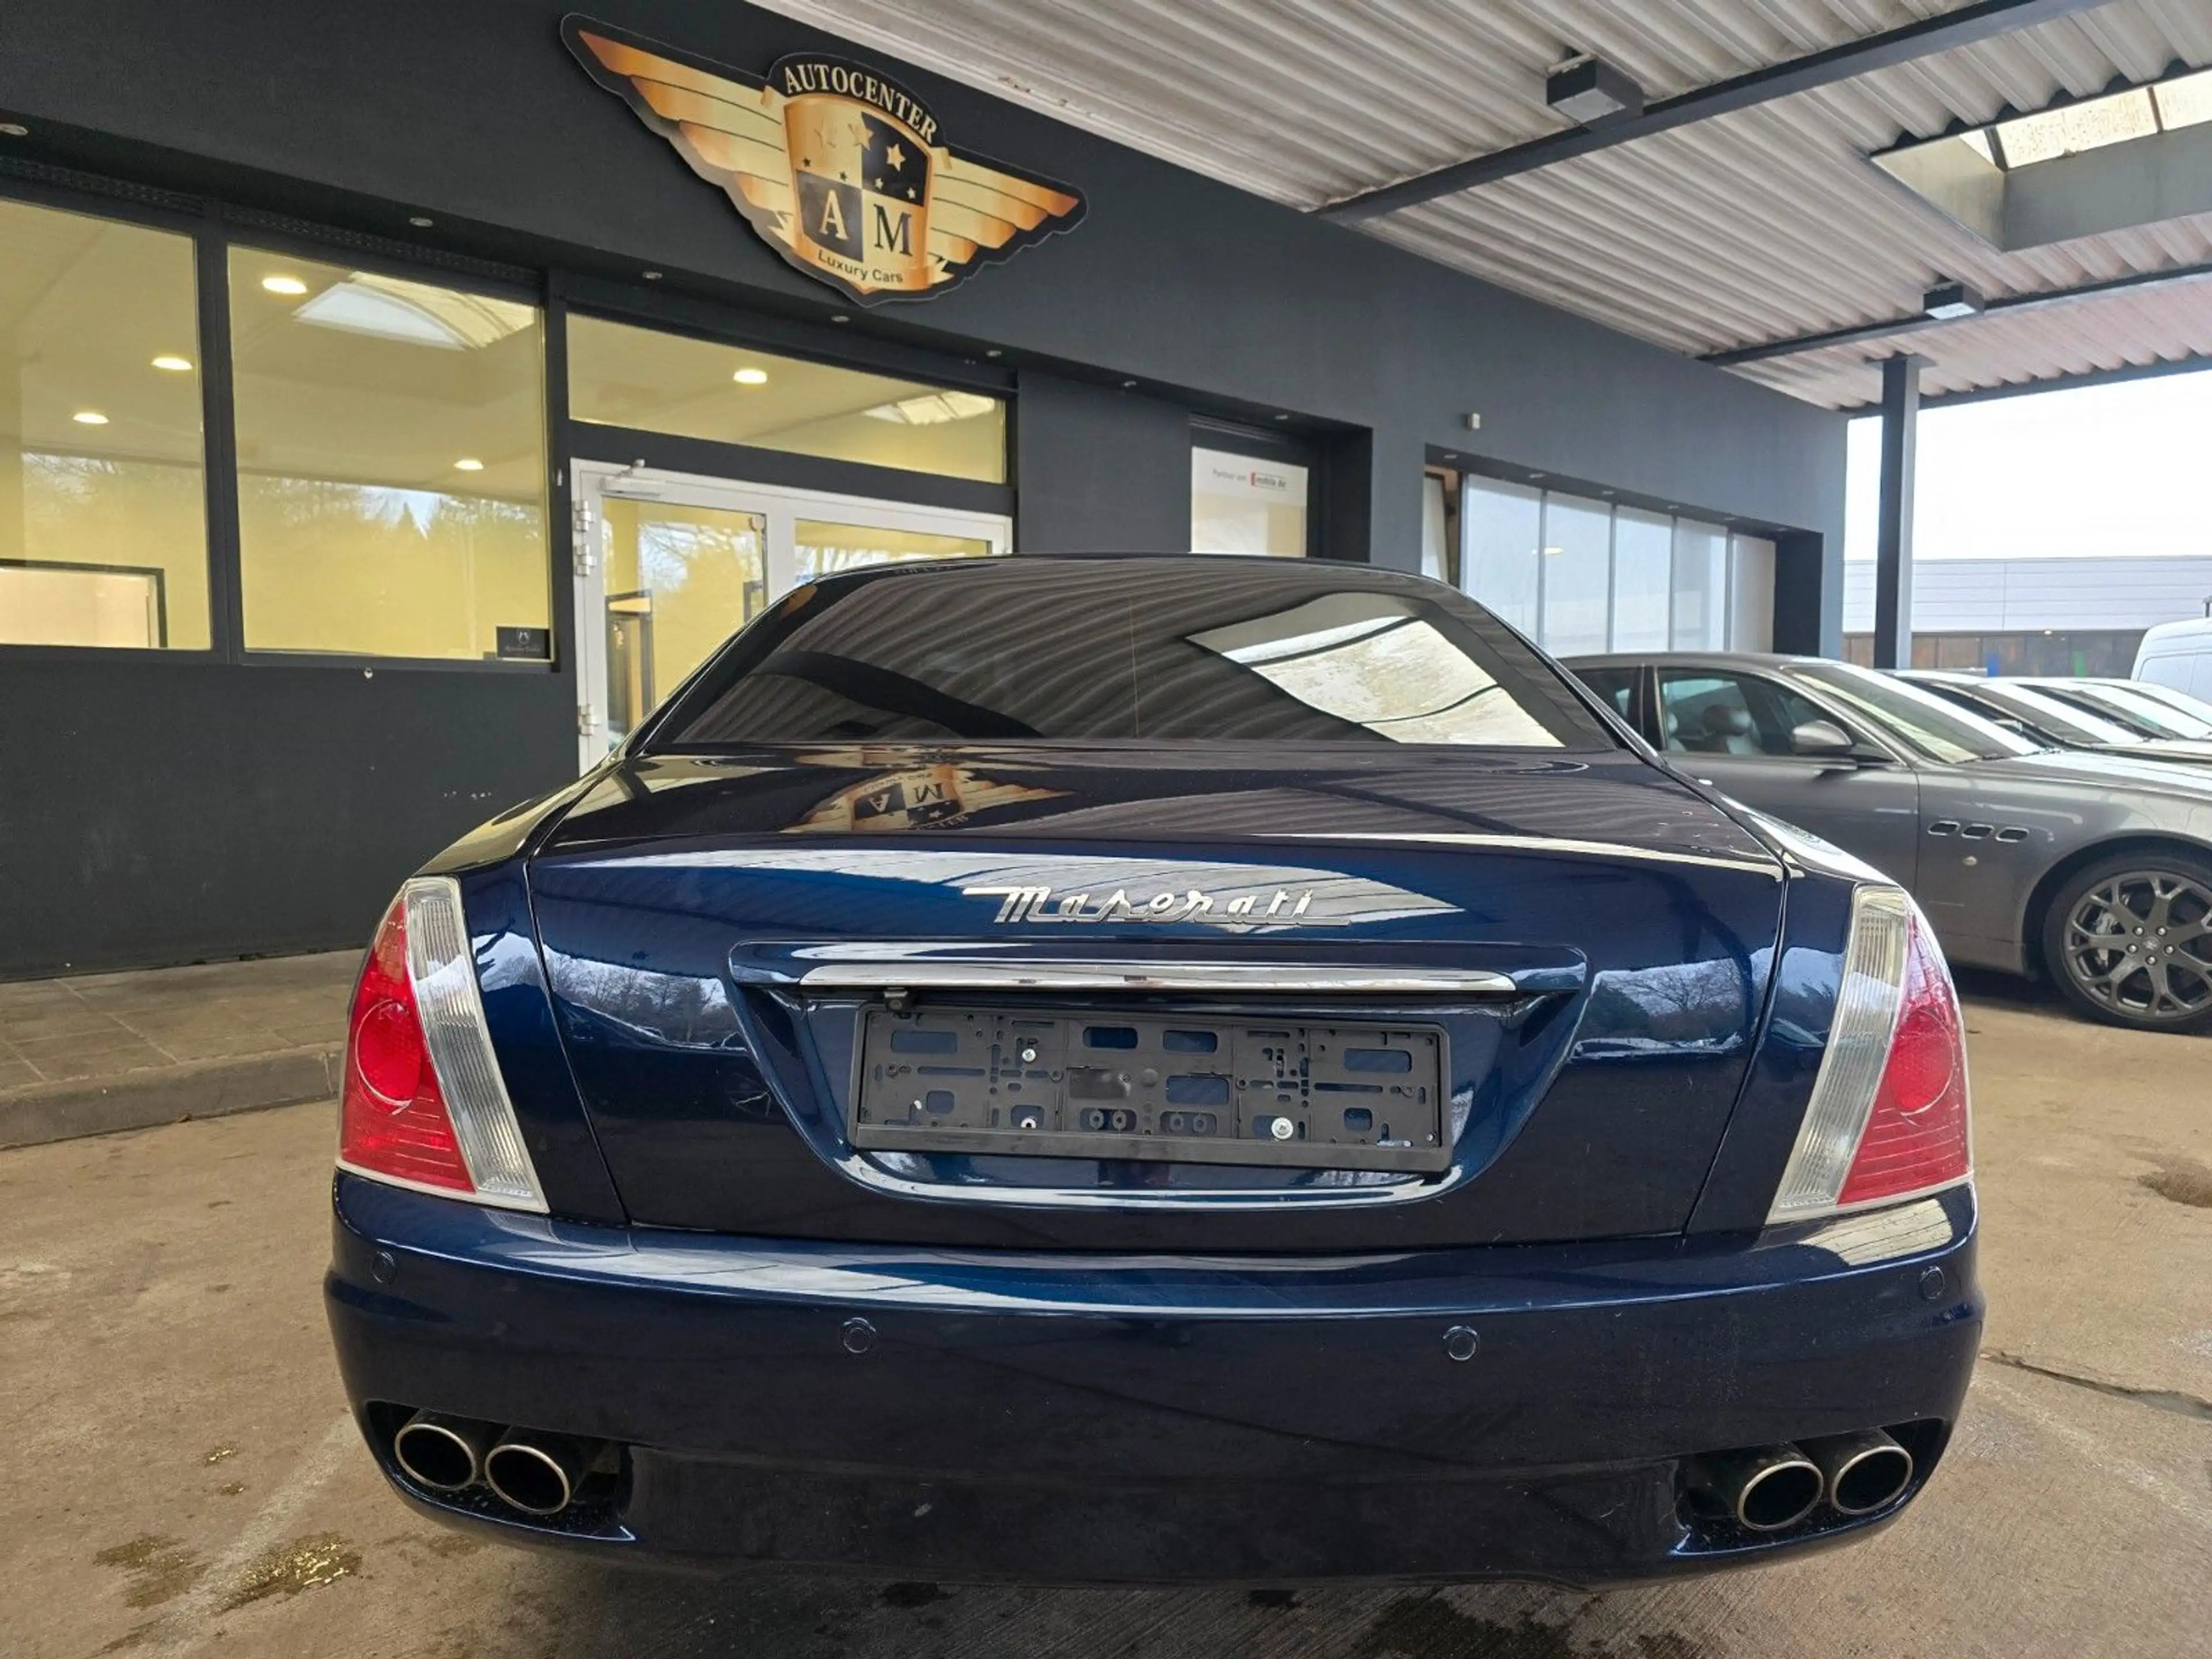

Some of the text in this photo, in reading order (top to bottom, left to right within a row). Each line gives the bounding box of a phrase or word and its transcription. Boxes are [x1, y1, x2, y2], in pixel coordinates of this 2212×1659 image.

[785, 63, 937, 144] AUTOCENTER
[819, 189, 913, 257] A M
[818, 249, 904, 283] Luxury Cars
[962, 886, 1350, 926] Maserati
